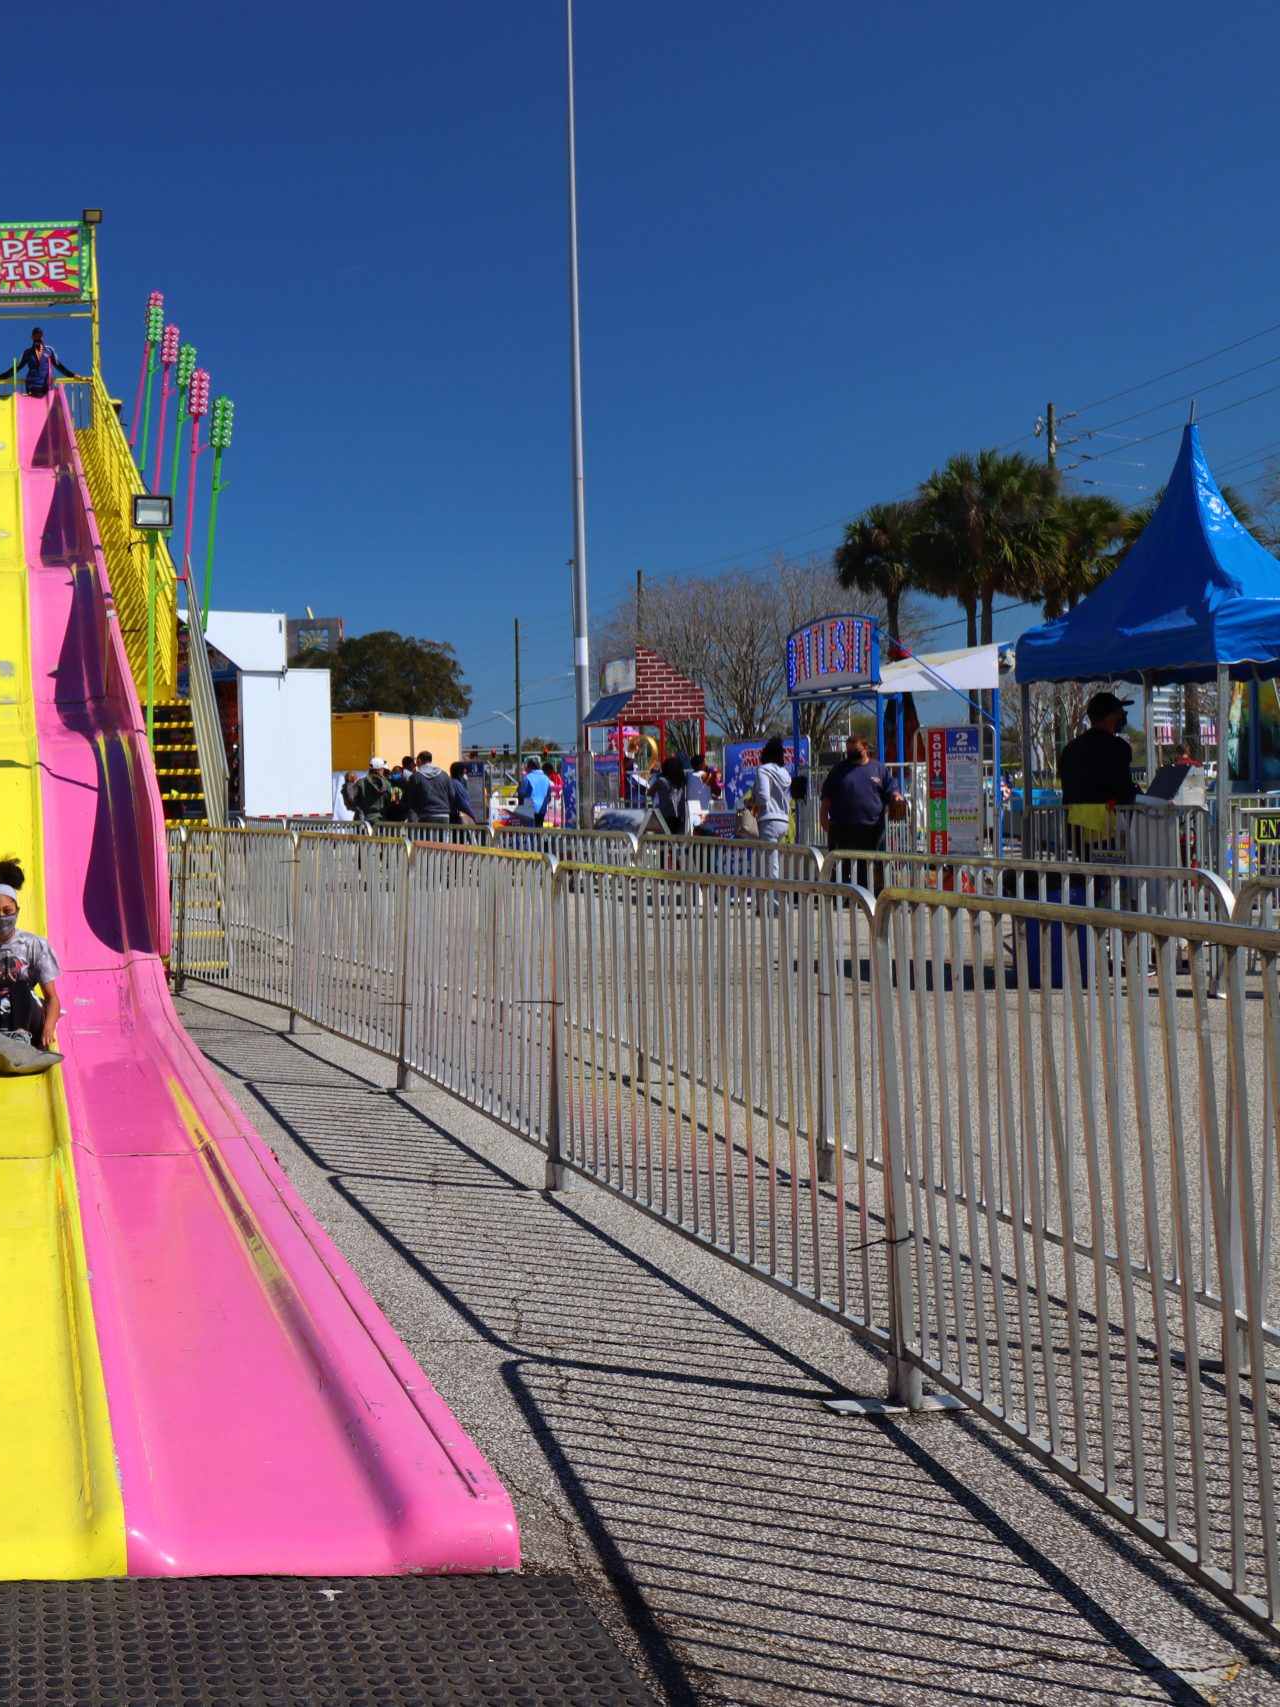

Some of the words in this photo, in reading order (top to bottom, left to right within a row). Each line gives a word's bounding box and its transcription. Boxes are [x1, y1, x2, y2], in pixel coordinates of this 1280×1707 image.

[11, 286, 55, 294] AMUSEMENTS
[788, 620, 872, 688] BATTLESHIP
[955, 731, 969, 747] 2
[932, 732, 942, 777] SORRY
[471, 763, 479, 773] 3
[934, 799, 943, 830] YES
[1260, 818, 1280, 838] EN
